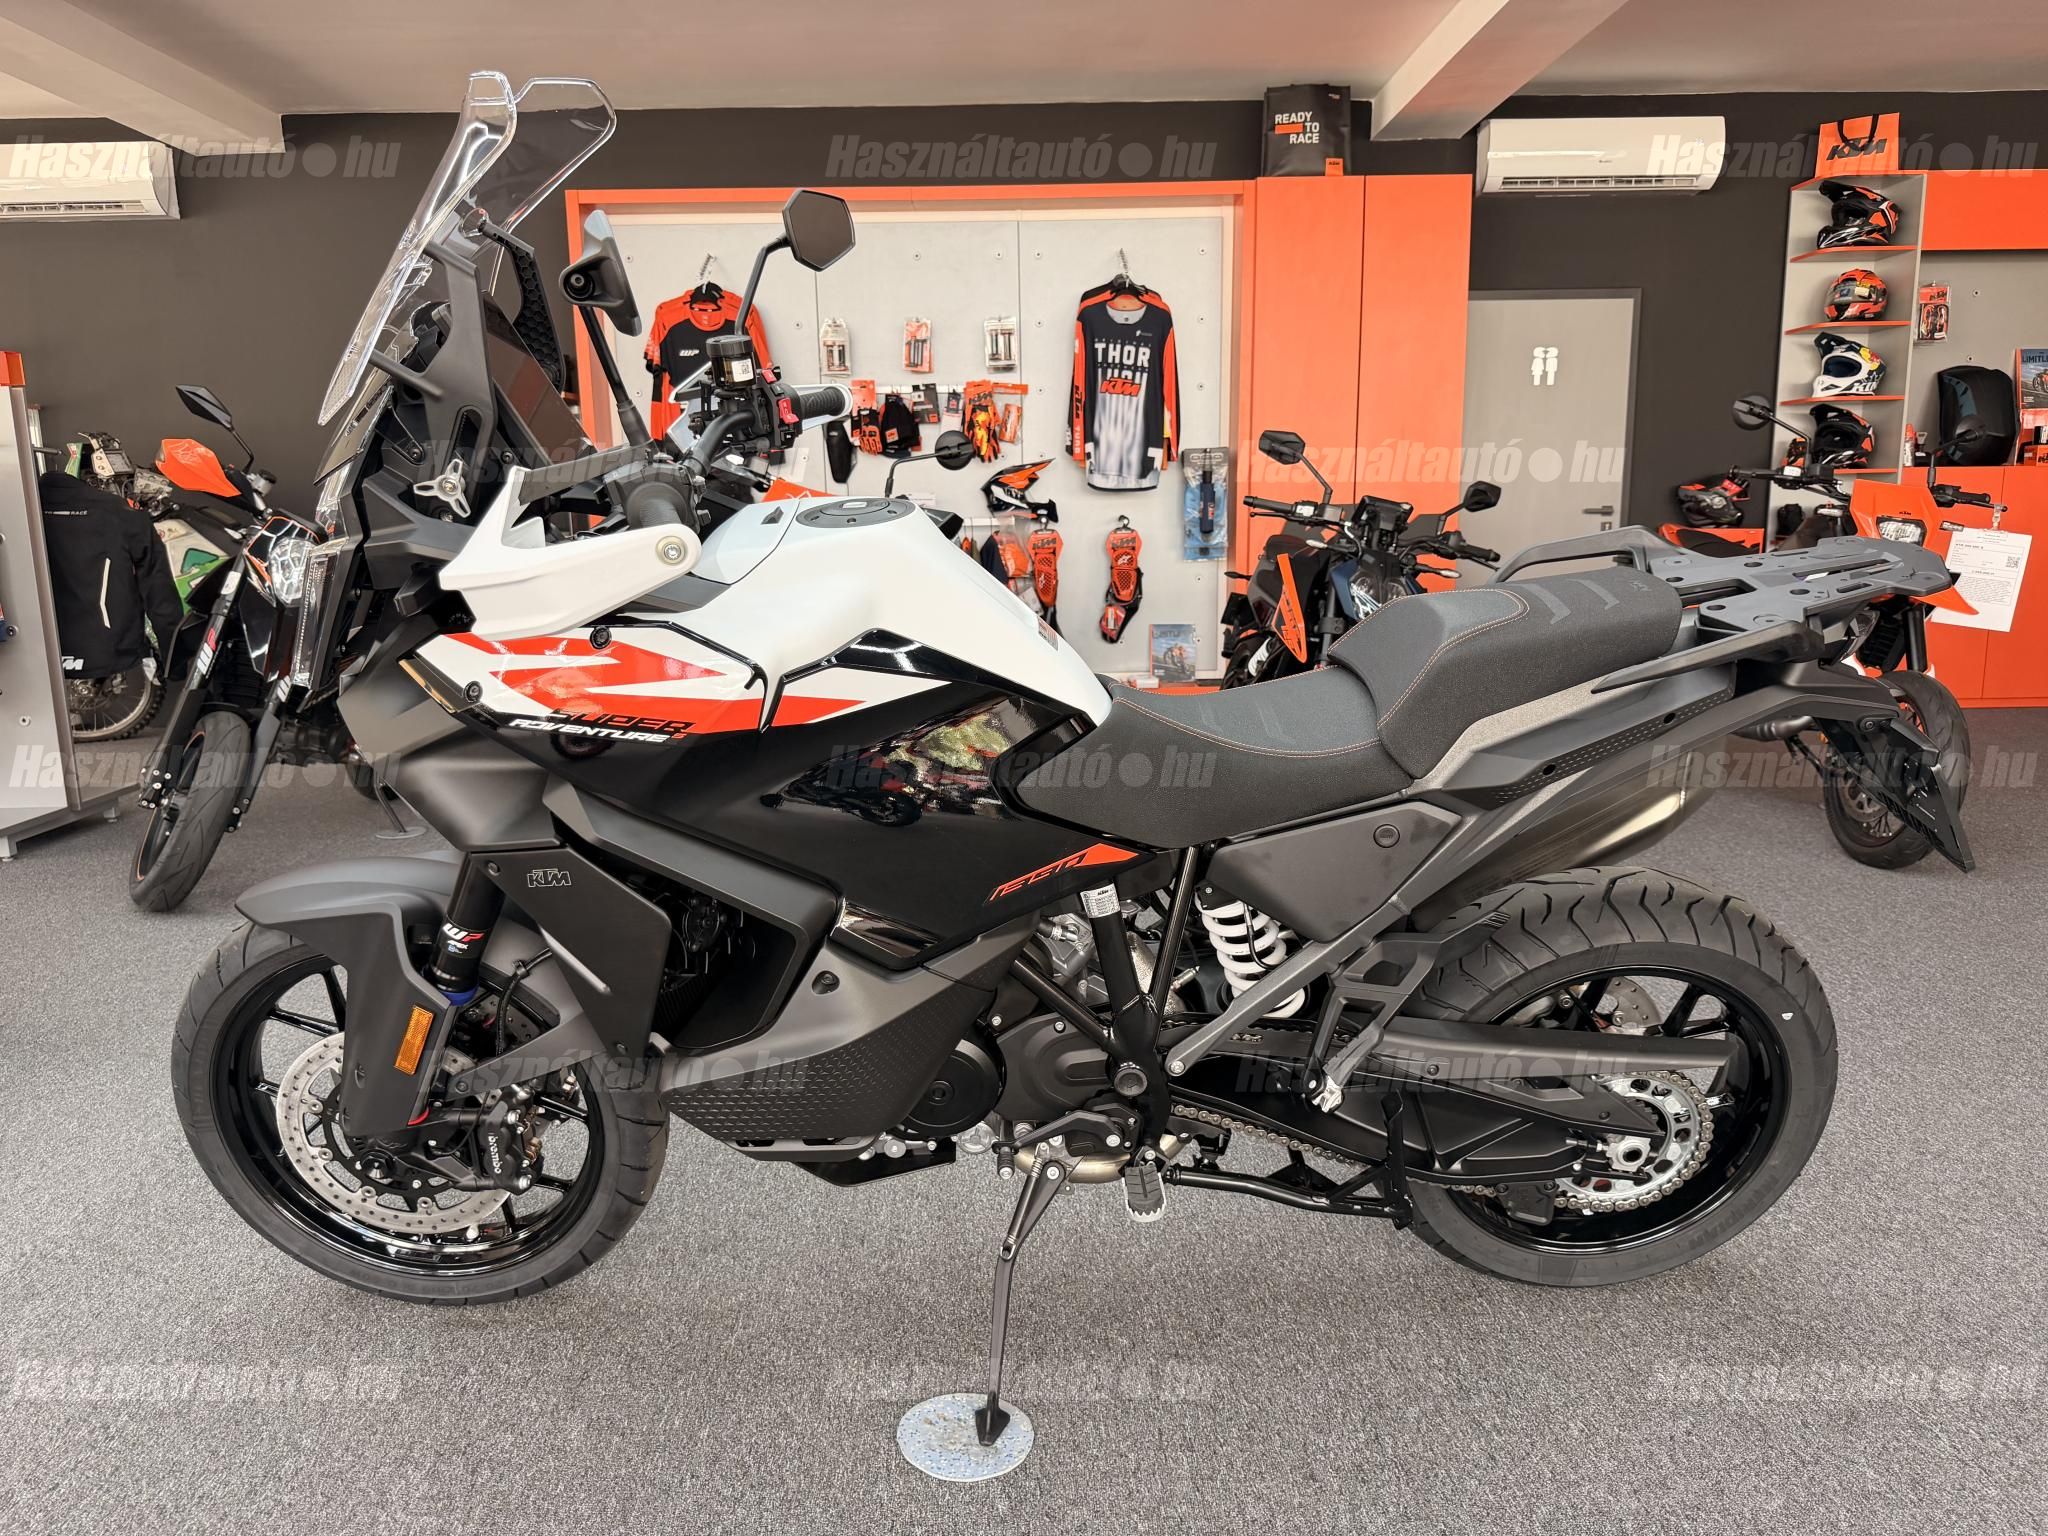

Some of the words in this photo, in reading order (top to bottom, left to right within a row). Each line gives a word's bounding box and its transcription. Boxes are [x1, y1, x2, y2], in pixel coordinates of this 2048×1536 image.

[1275, 111, 1313, 125] READY
[1305, 122, 1320, 133] TO
[1289, 133, 1320, 145] RACE
[1094, 342, 1151, 368] THOR
[2022, 354, 2048, 364] LIMITL
[1100, 378, 1141, 396] KTM
[62, 656, 84, 670] TM
[549, 708, 696, 733] SUPER
[509, 718, 671, 743] ADVENTURE
[527, 868, 571, 887] KTM
[442, 922, 485, 942] WP
[488, 1136, 503, 1174] brembo
